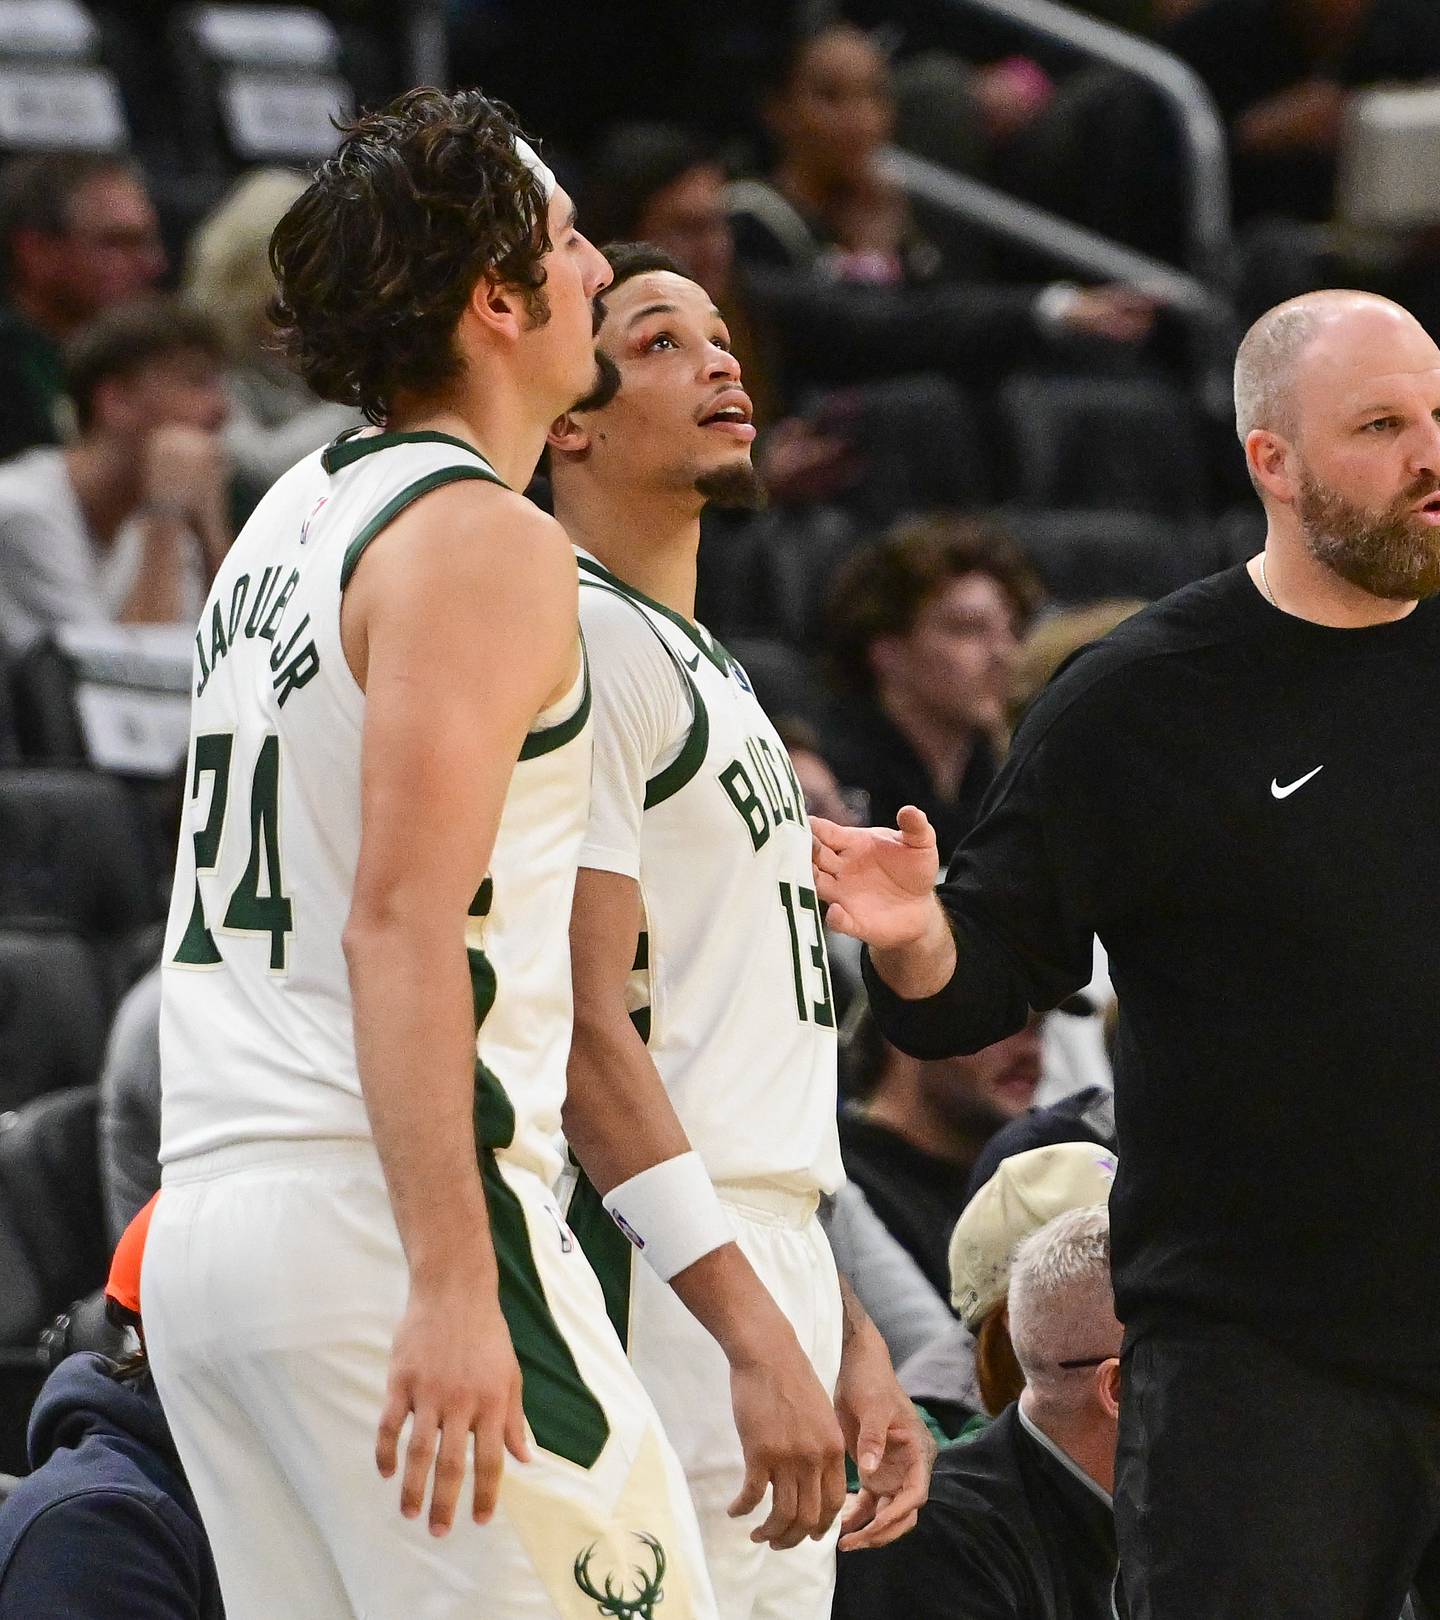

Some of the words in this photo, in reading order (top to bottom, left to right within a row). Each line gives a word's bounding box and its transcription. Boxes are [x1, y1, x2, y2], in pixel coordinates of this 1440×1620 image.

[269, 612, 320, 709] JR
[168, 732, 294, 971] 24
[778, 881, 835, 1028] 13
